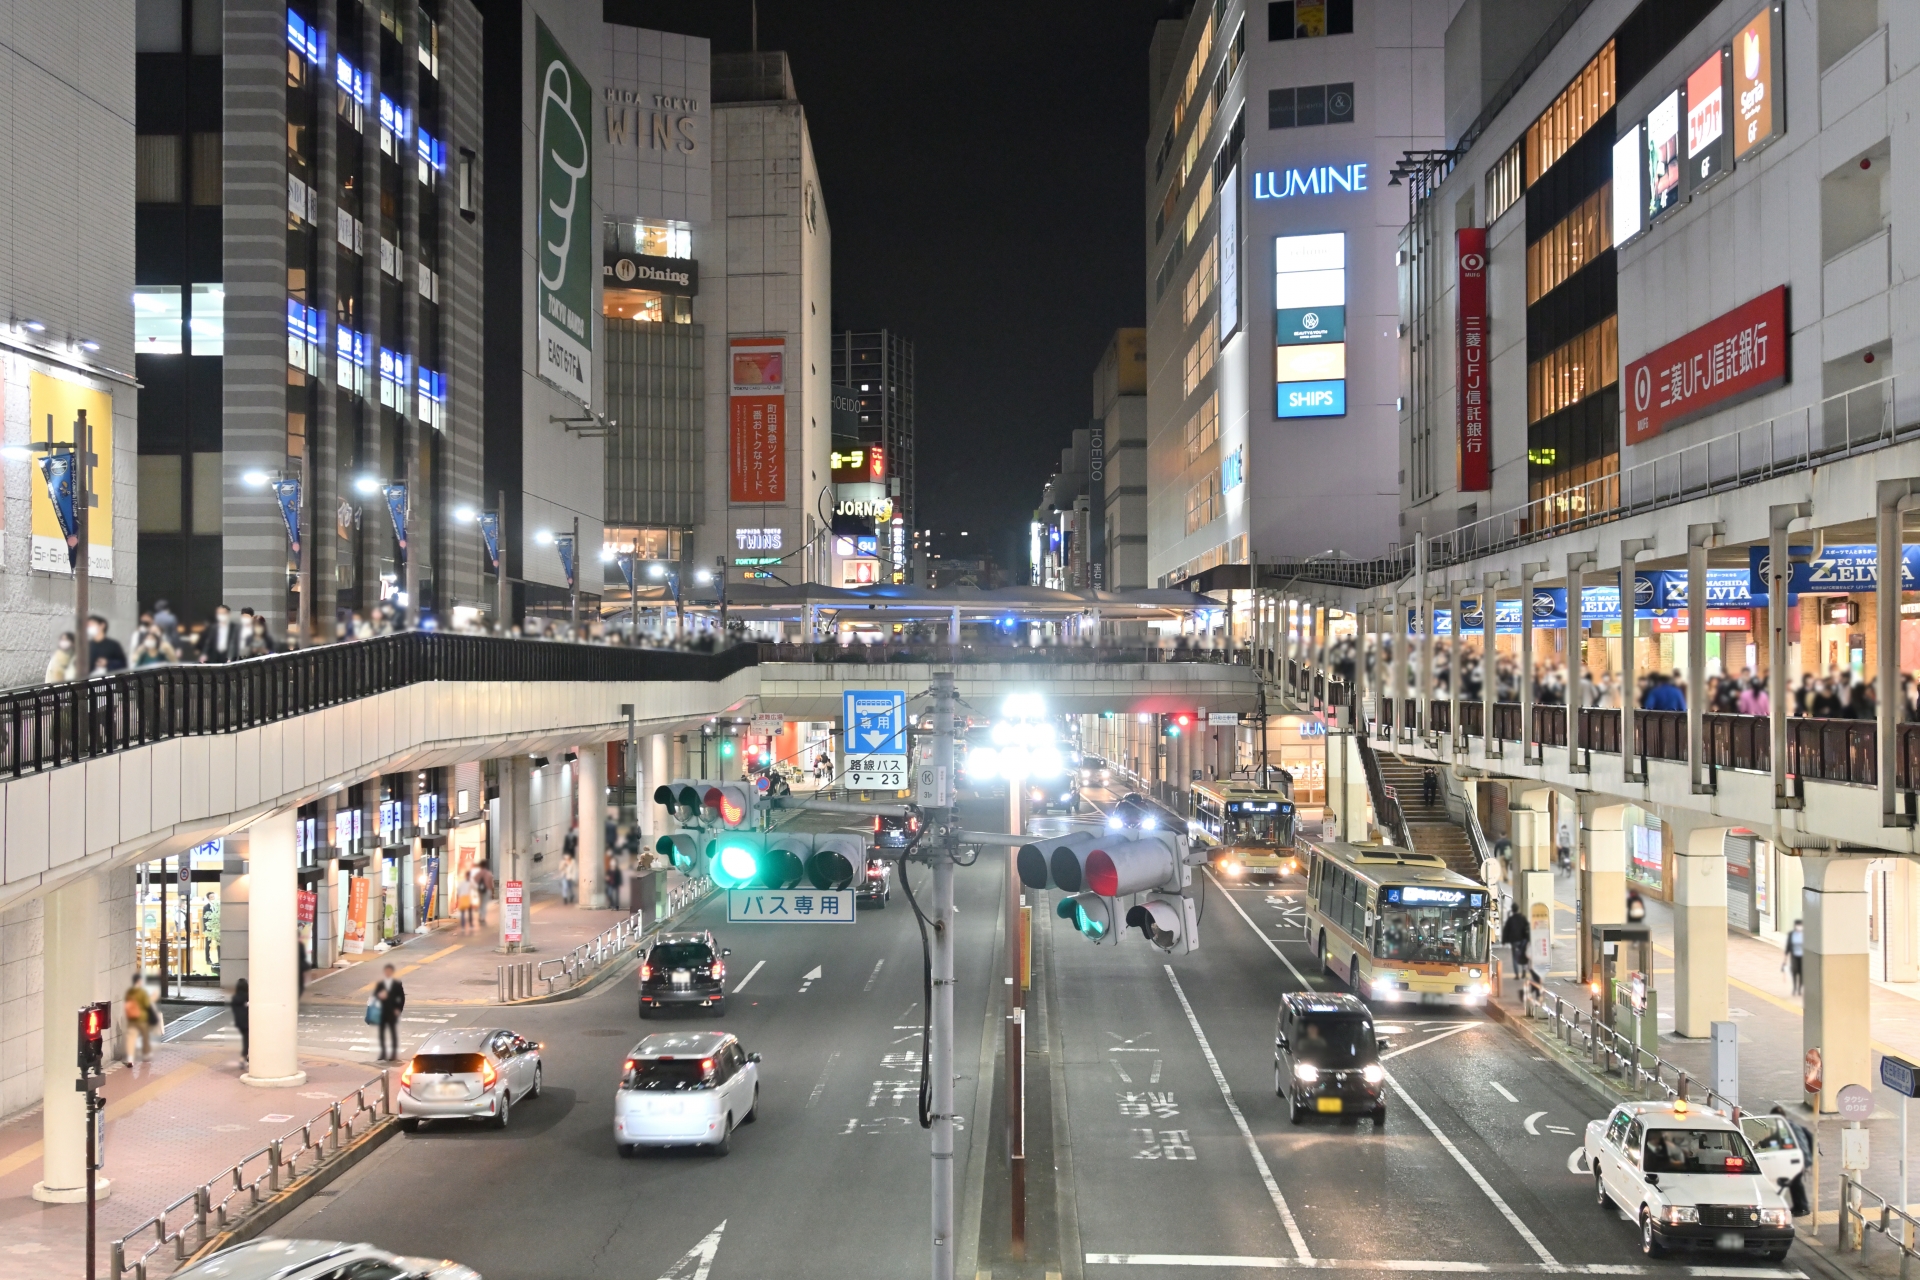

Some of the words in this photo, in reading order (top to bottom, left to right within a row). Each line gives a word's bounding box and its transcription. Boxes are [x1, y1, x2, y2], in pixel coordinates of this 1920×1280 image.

[607, 88, 641, 105] HIDA
[655, 95, 699, 112] TOKYU
[1741, 80, 1764, 115] Seria
[607, 107, 699, 155] WINS
[1690, 100, 1720, 150] ユザワヤ
[1748, 120, 1758, 143] 6F
[1701, 156, 1710, 178] 6F
[1255, 163, 1367, 199] LUMINE
[638, 266, 689, 286] Dining
[548, 338, 563, 370] EAST
[1660, 321, 1768, 410] 三菱UFJ信託銀行
[1466, 316, 1482, 453] 三菱UFJ信託銀行
[1289, 390, 1333, 407] SHIPS
[1637, 416, 1649, 433] MUFG
[752, 404, 763, 495] 一番おトクなカード。
[767, 404, 777, 494] 町田東急ツインズで
[1091, 428, 1103, 482] HOEIDO
[837, 501, 881, 516] JORNA
[736, 535, 782, 549] TWINS
[858, 541, 876, 552] GU
[1809, 558, 1914, 582] ZELVA
[1666, 581, 1752, 600] ZLVIA
[1677, 617, 1746, 626] 三J信託銀行
[860, 716, 890, 729] 専用
[850, 759, 901, 771] 路線バス
[743, 895, 839, 915] バス専用
[1845, 1104, 1867, 1112] のりば
